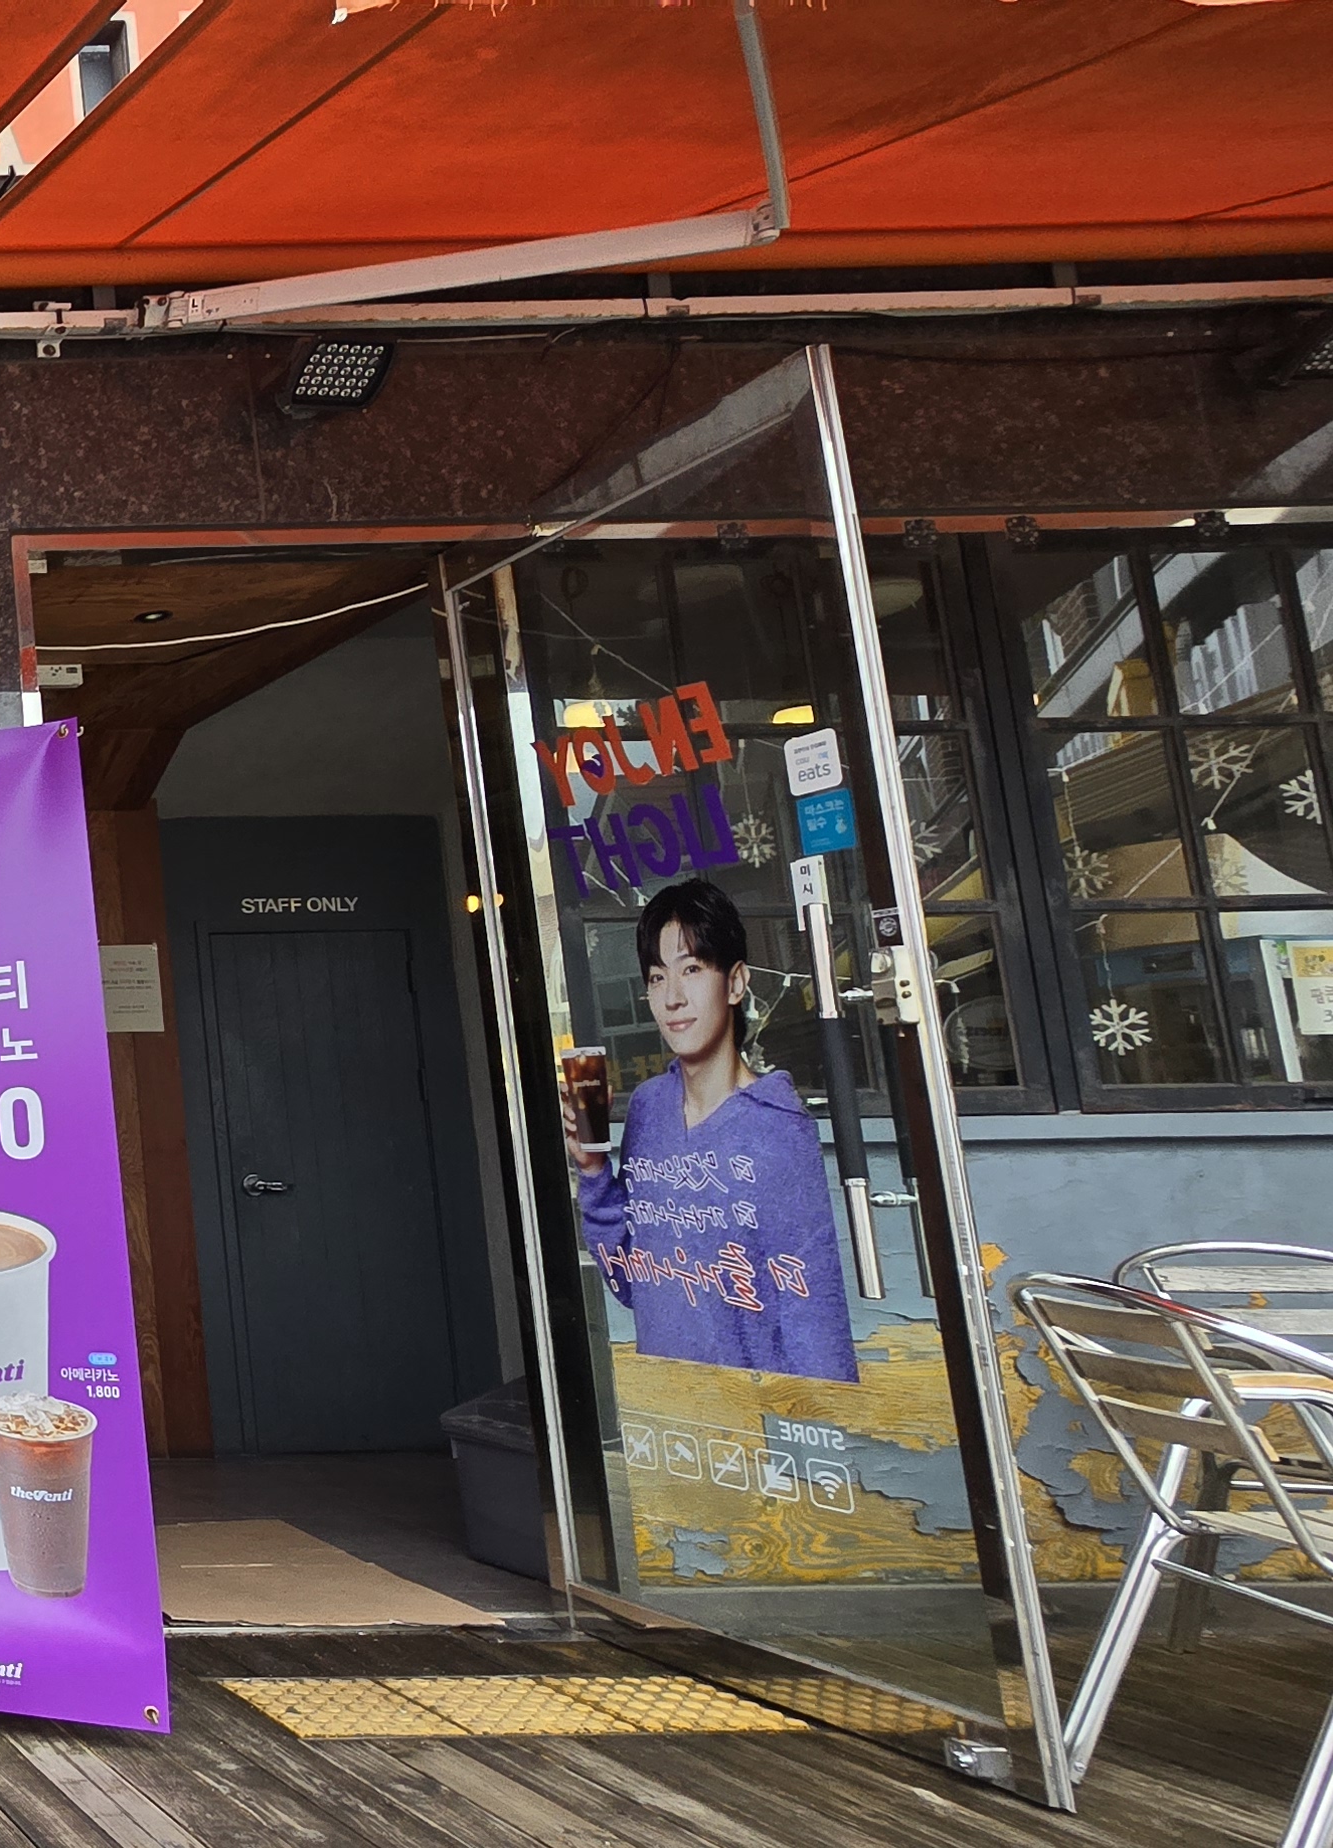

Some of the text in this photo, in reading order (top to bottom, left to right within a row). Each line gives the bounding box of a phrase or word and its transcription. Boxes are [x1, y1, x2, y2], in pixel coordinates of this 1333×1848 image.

[798, 763, 832, 783] eats
[240, 896, 360, 915] STAFF ONLY
[60, 1366, 121, 1383] 아메리카노
[9, 1484, 74, 1503] theVenti
